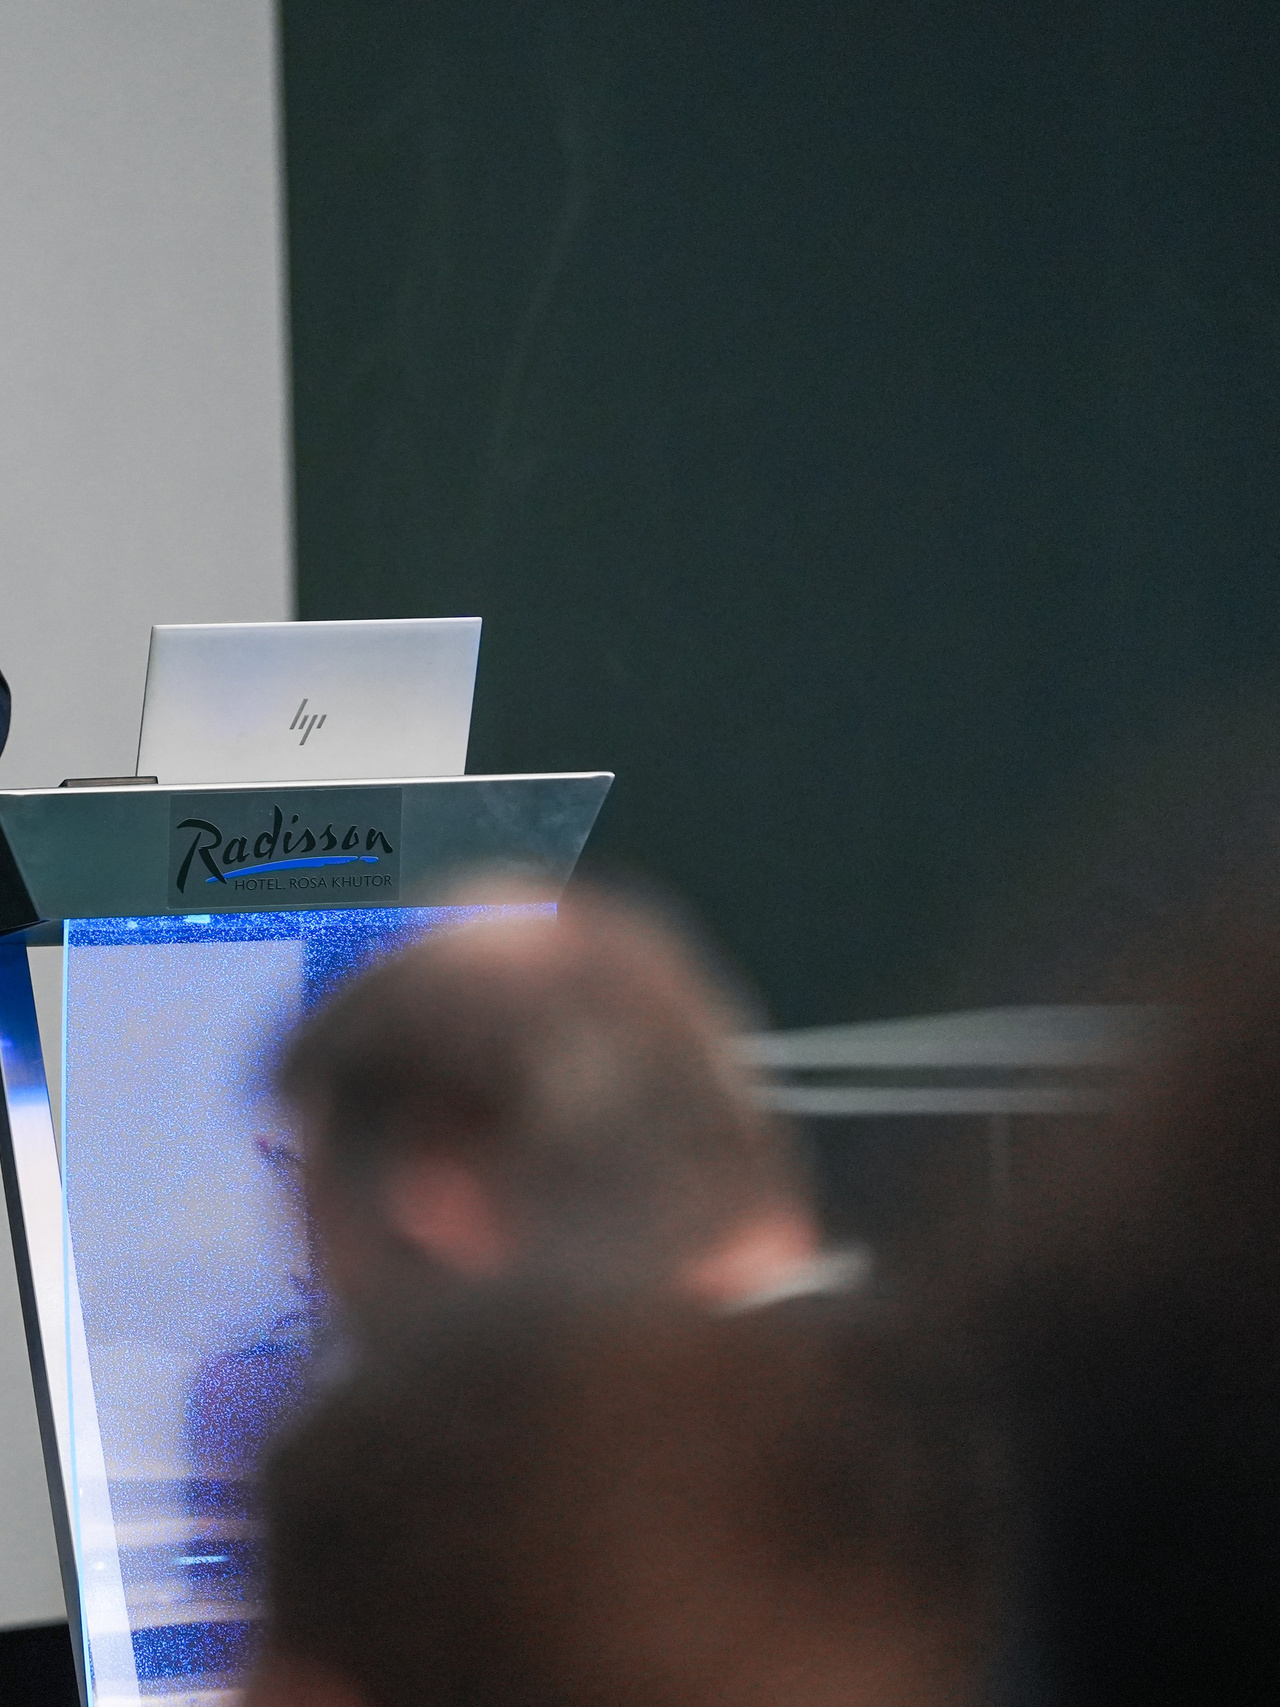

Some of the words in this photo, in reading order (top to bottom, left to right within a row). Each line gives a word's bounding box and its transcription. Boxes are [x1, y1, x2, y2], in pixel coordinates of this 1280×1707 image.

[289, 698, 328, 746] hp
[176, 803, 394, 894] Radisson
[289, 877, 328, 890] ROSA
[332, 874, 393, 888] KHUTOR
